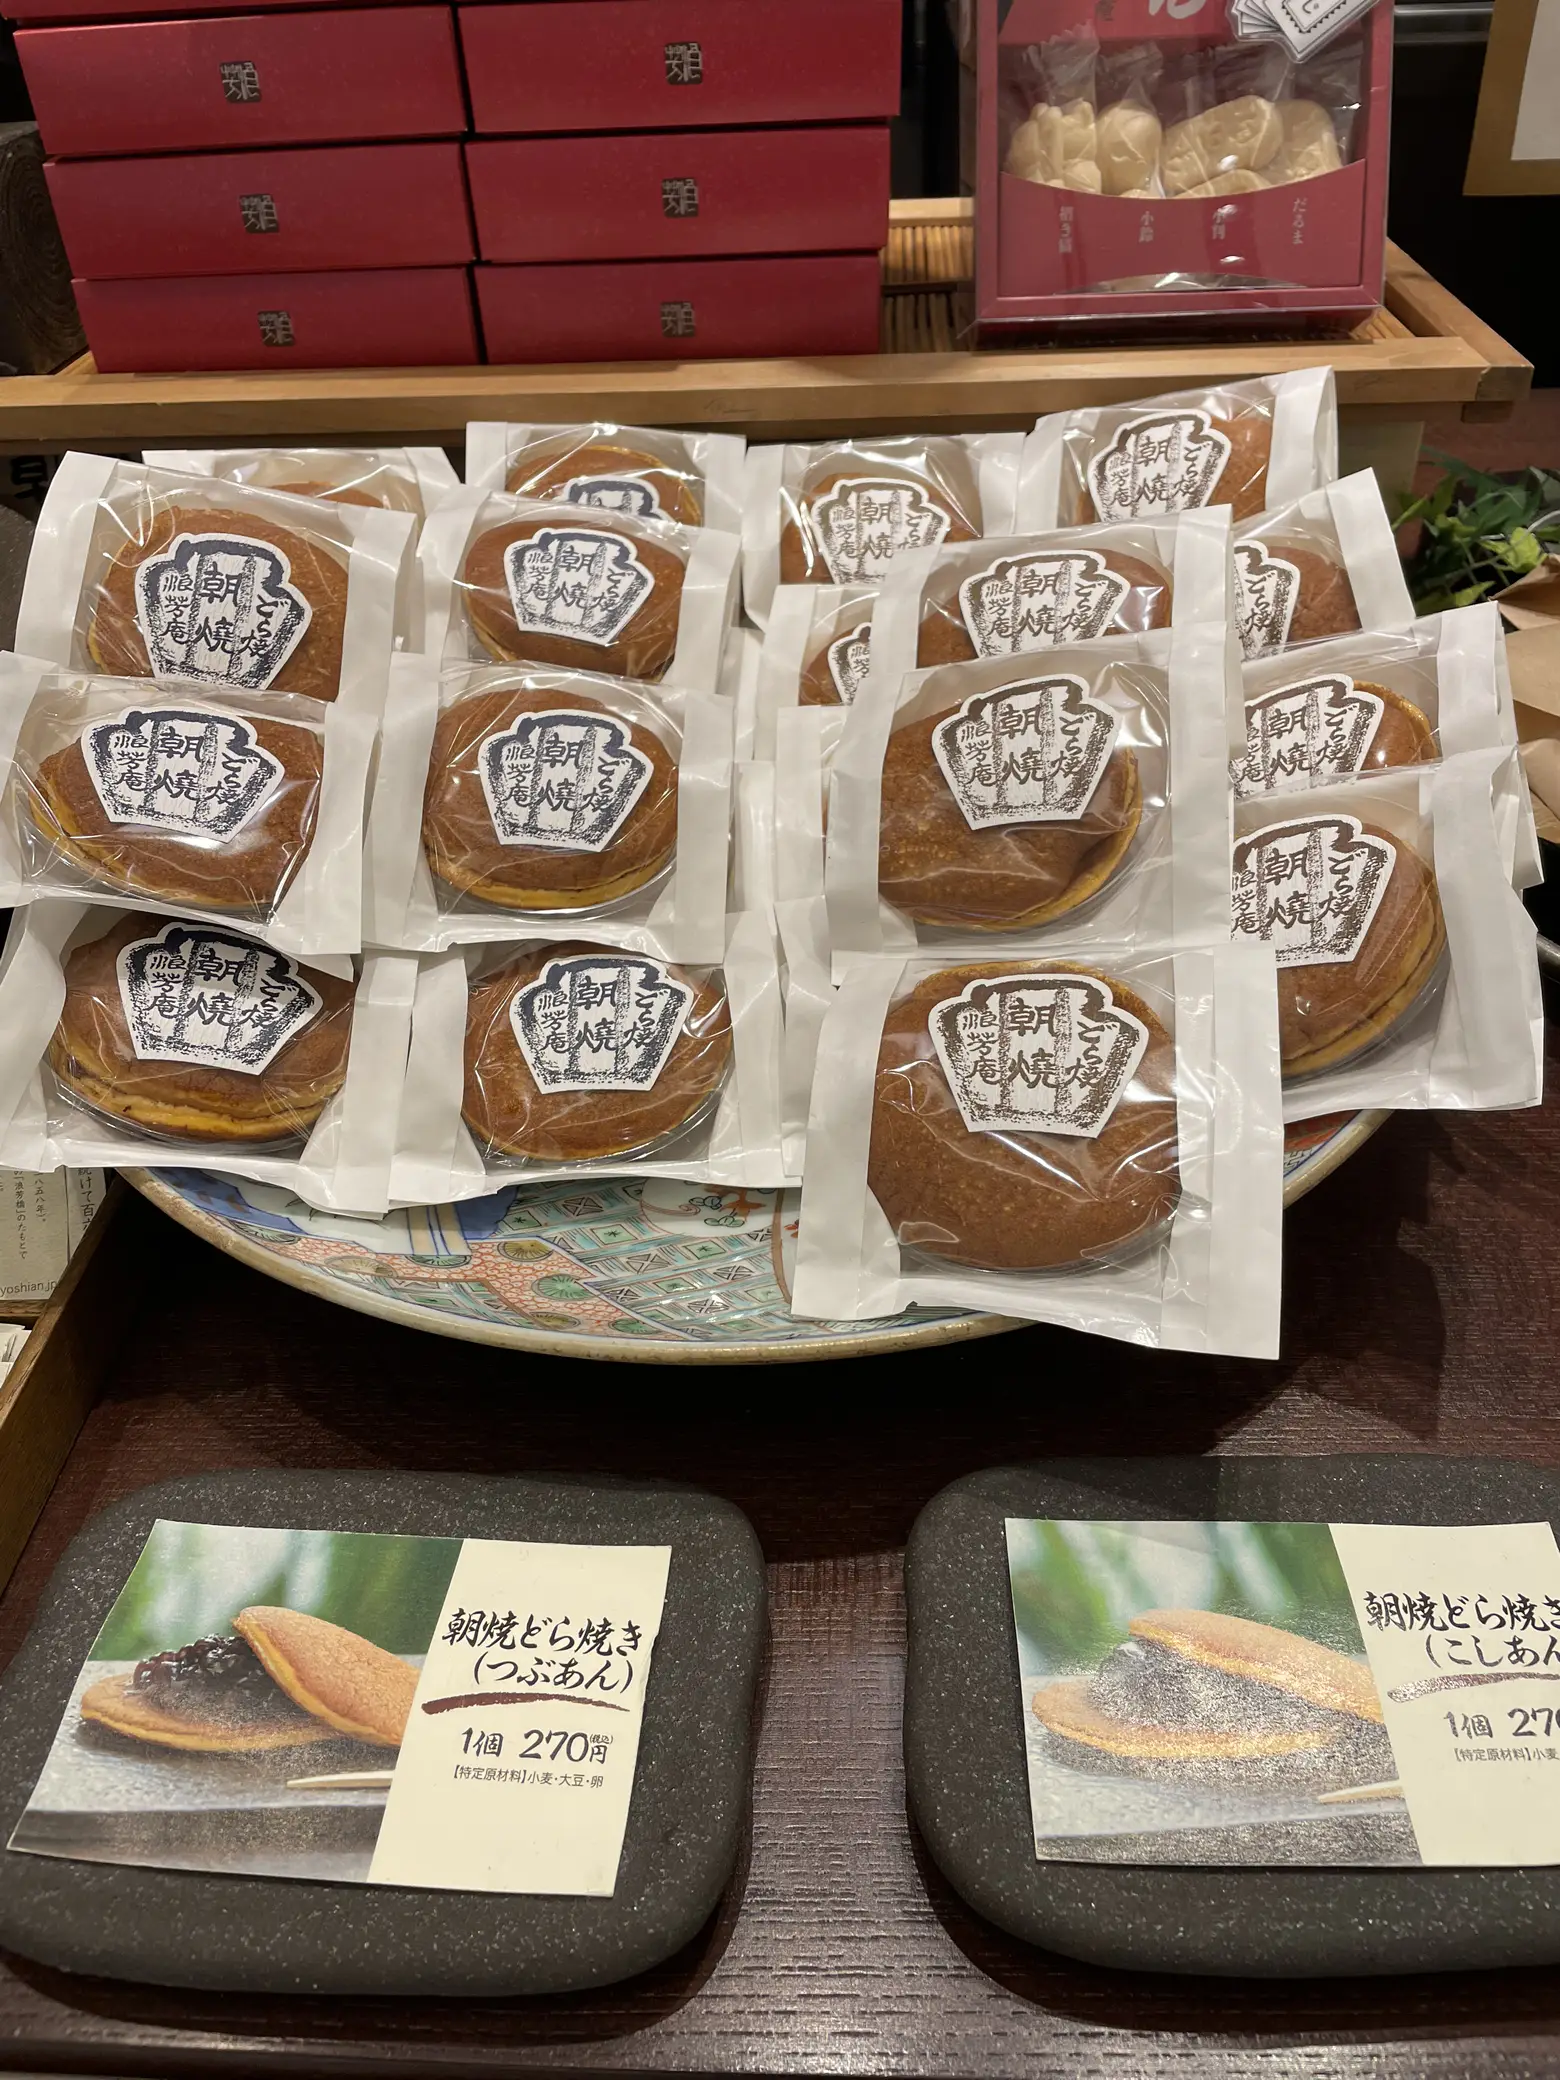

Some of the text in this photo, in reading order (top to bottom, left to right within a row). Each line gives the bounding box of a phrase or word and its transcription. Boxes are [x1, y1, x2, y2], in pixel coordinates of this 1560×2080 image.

[442, 1607, 642, 1657] 朝焼どら焼き
[473, 1651, 634, 1694] (つぶあん)
[1444, 1707, 1560, 1739] 1個 27
[461, 1727, 503, 1758] 1個
